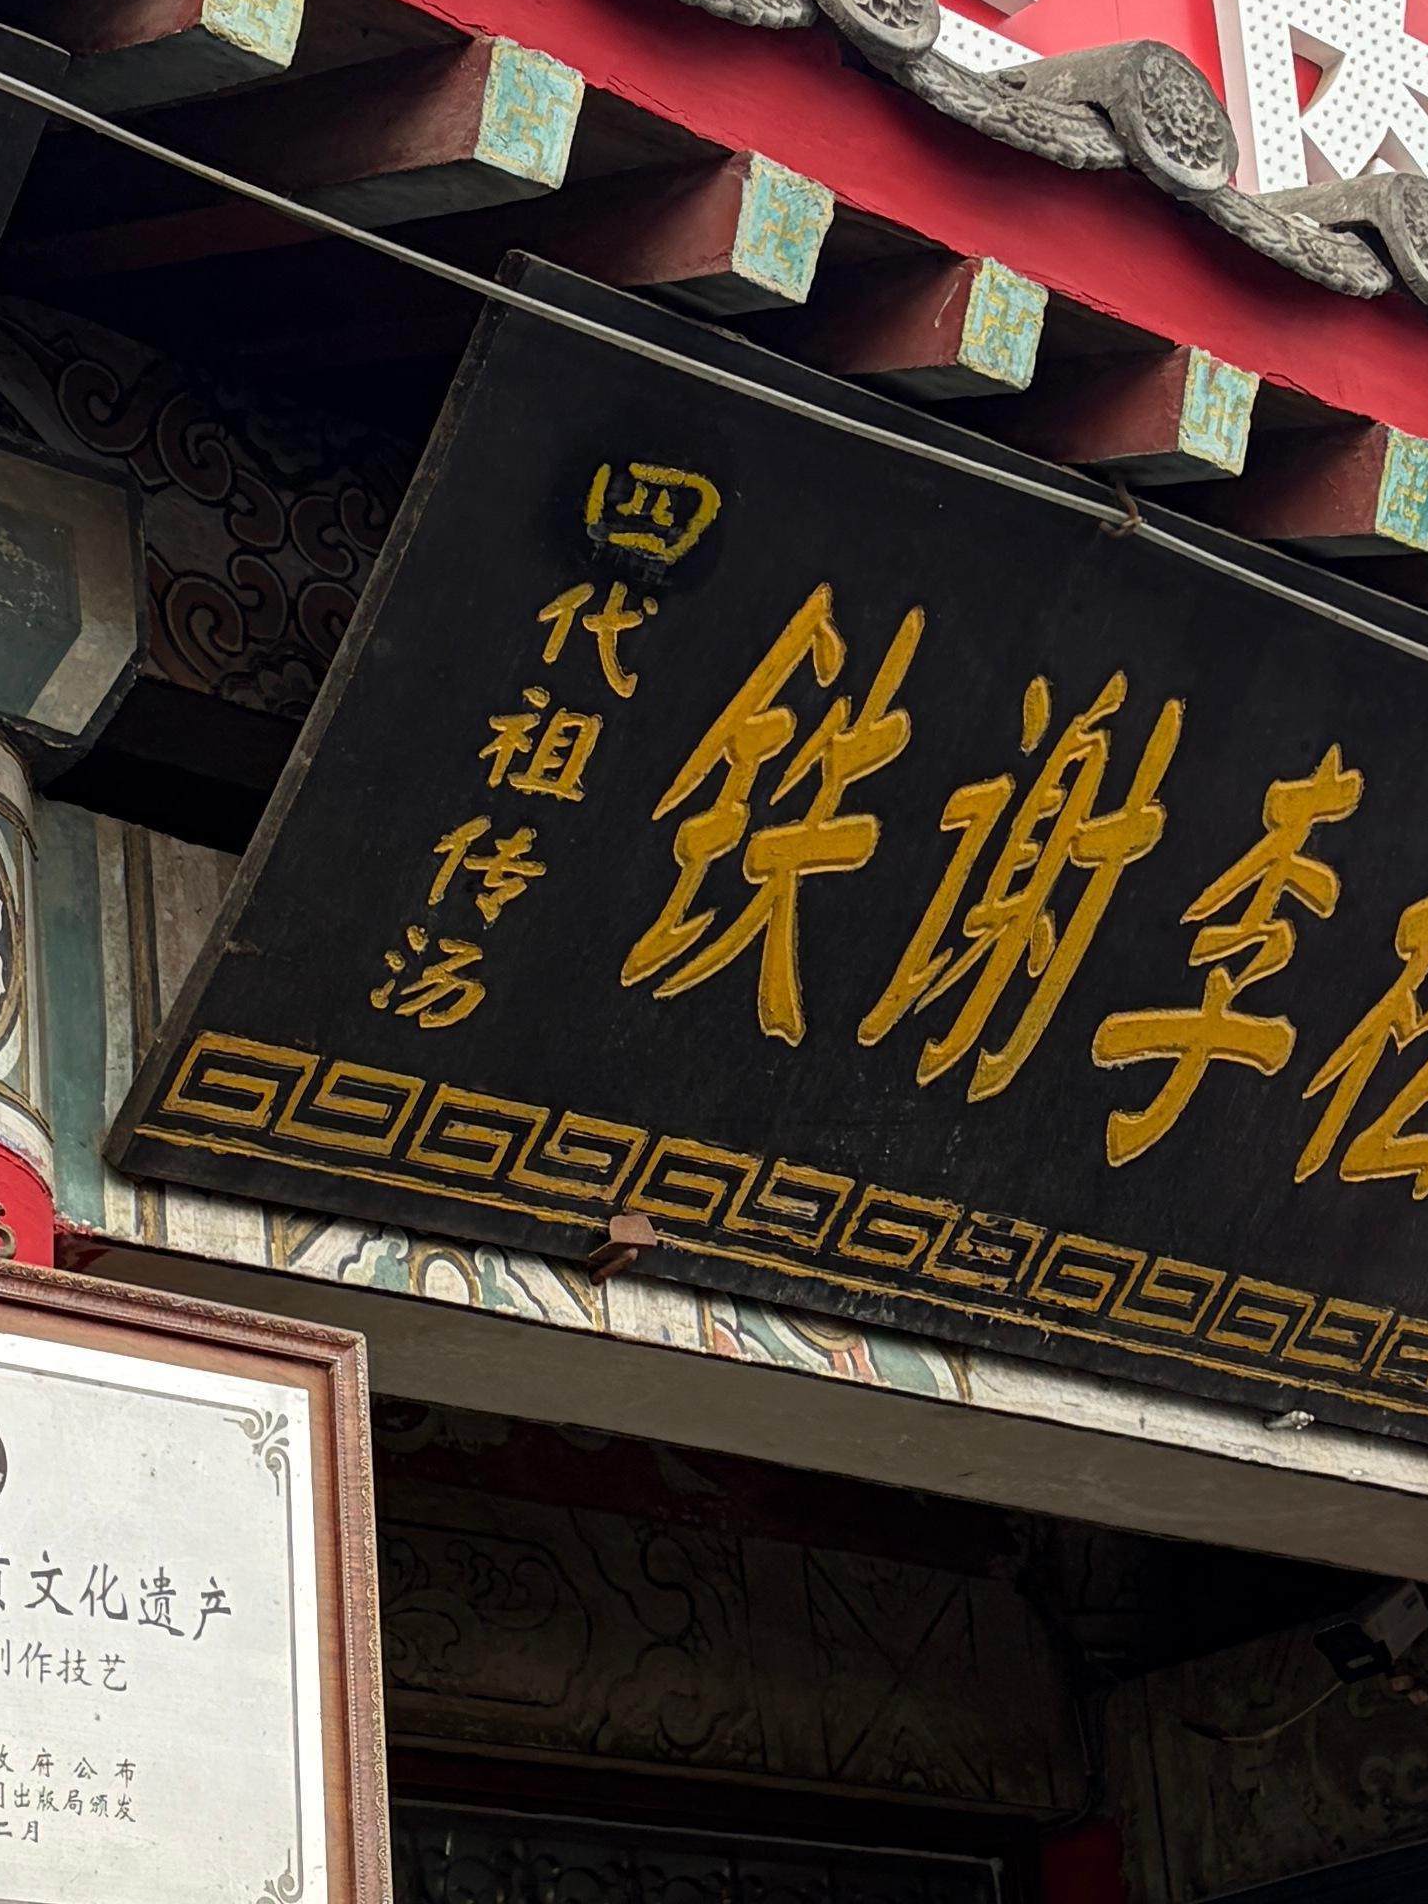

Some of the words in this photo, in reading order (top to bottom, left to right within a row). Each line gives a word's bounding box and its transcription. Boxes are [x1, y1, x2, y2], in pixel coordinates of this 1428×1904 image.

[370, 460, 722, 1030] 四代祖传汤
